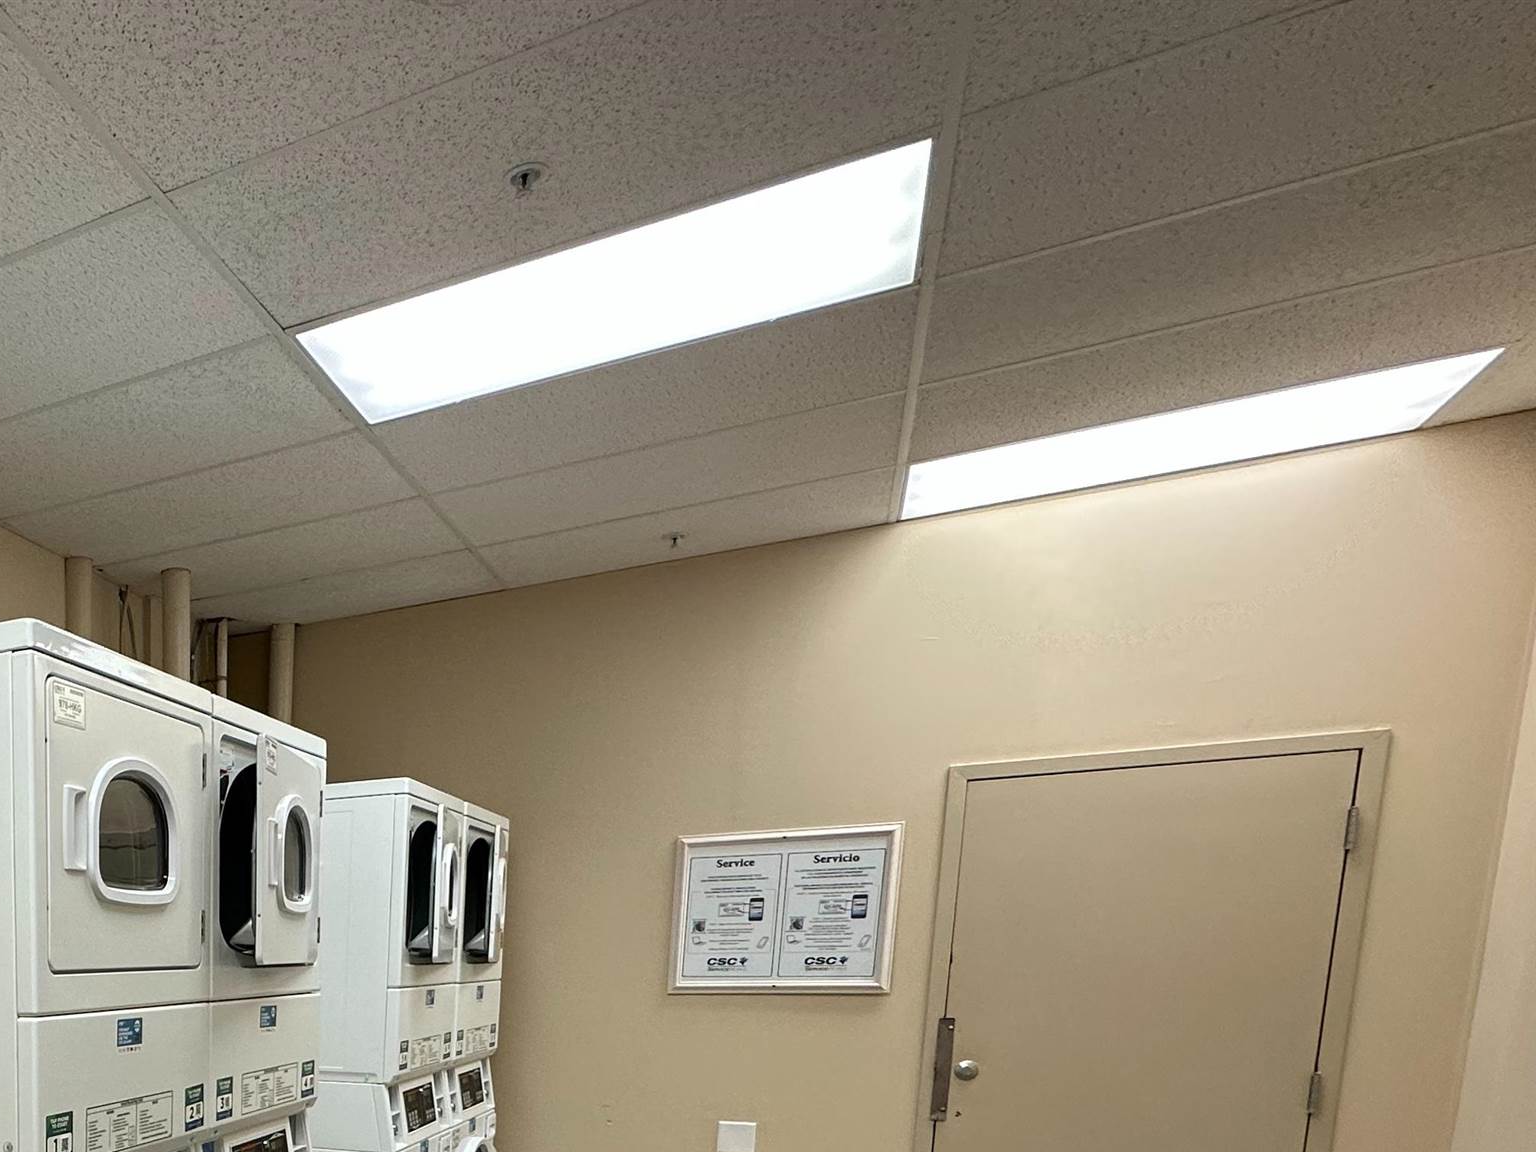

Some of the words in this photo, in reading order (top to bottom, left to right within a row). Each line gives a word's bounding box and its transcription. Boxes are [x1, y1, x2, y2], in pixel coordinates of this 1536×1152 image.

[716, 858, 756, 868] Service
[813, 854, 860, 865] Servicio
[706, 957, 739, 966] CSC
[804, 956, 837, 965] CSC
[189, 1106, 195, 1119] 2
[53, 1138, 58, 1152] 1
